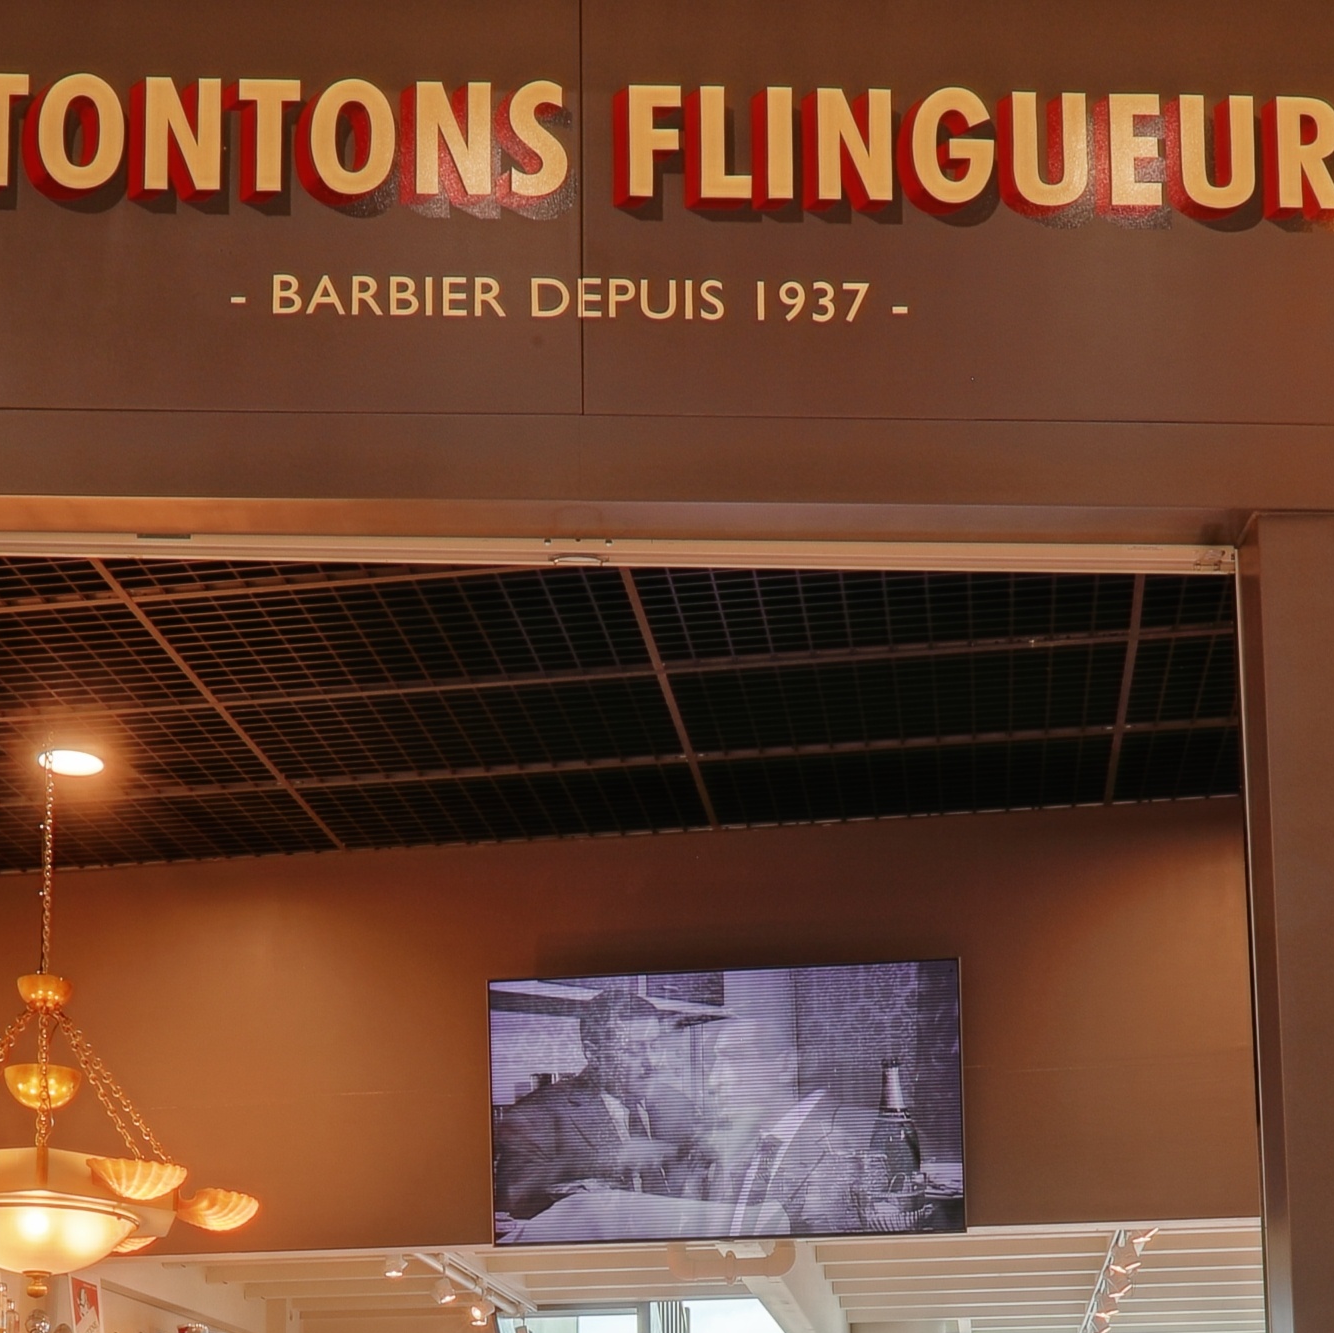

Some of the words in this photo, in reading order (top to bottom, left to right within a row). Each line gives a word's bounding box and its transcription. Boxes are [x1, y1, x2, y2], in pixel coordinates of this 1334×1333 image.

[272, 274, 507, 318] BARBIER
[531, 277, 725, 321] DEPUIS
[755, 280, 871, 323] 1937
